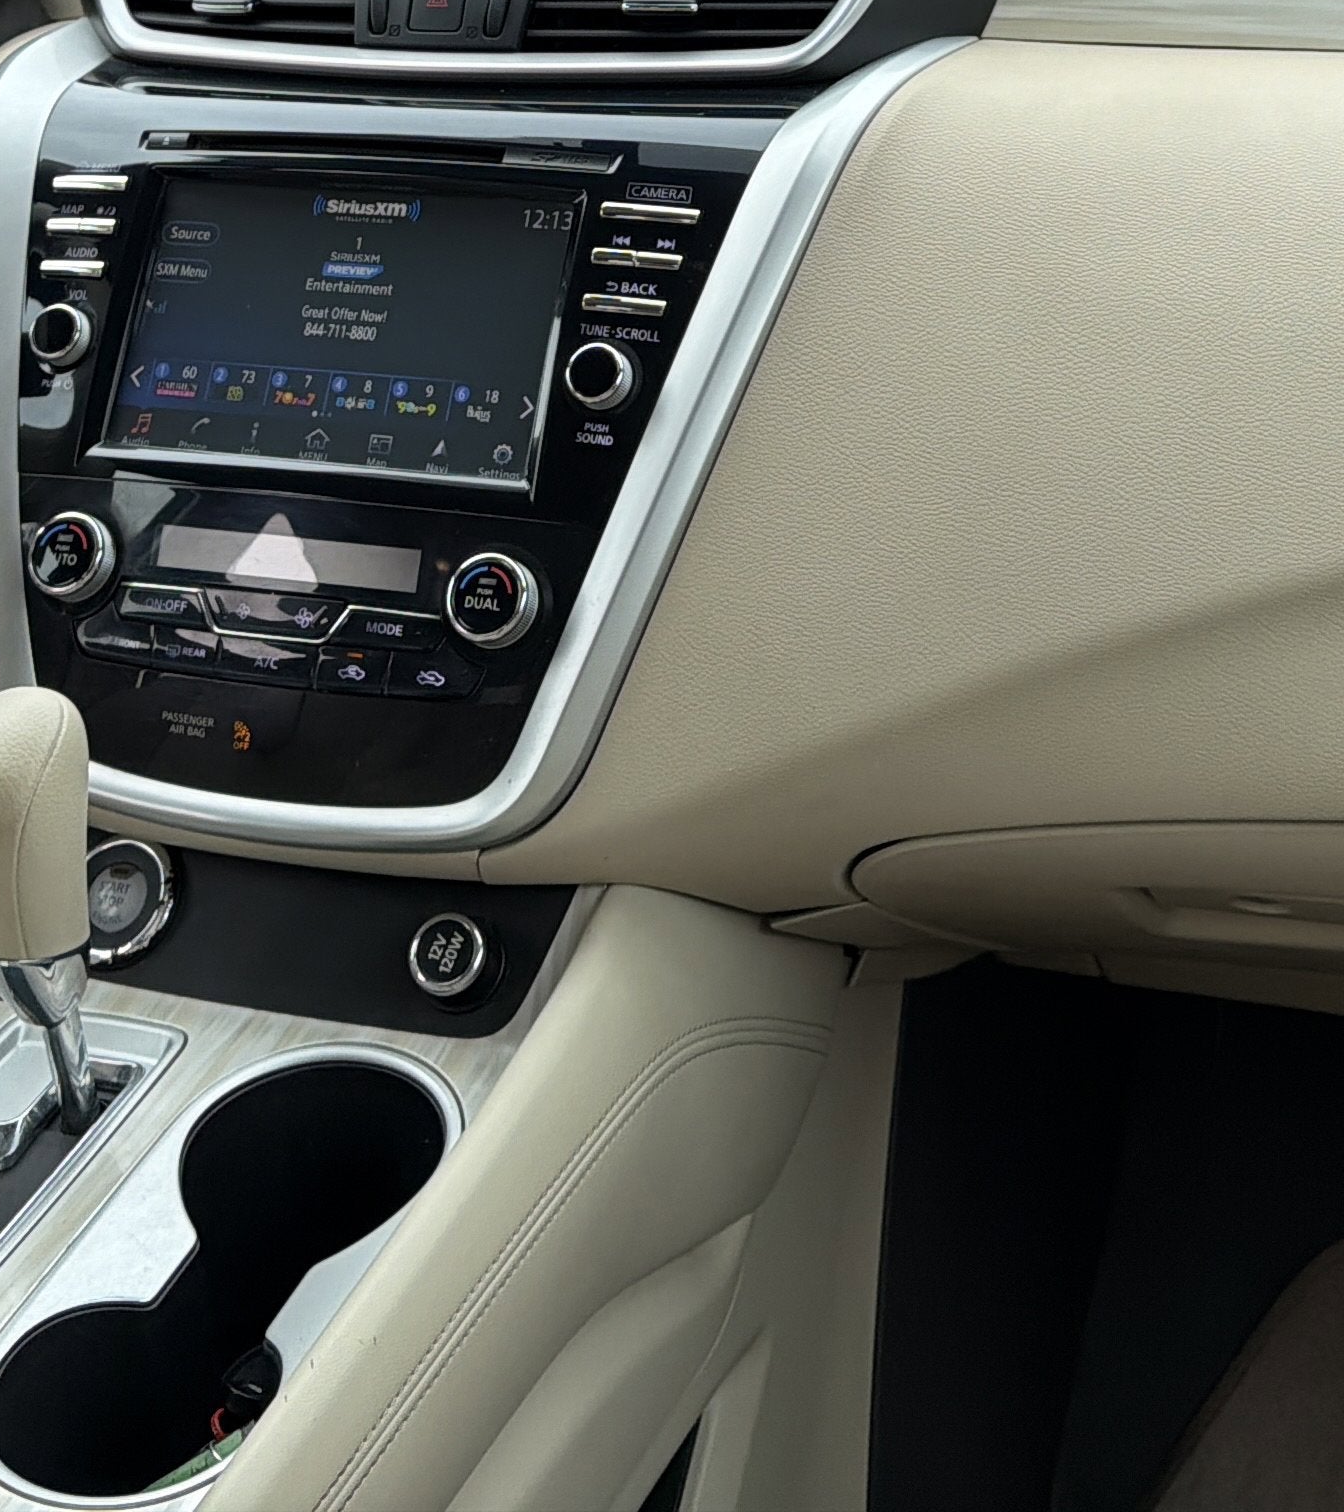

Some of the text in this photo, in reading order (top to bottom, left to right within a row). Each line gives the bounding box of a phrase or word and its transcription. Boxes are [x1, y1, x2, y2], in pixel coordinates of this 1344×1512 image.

[631, 185, 688, 201] CAMERA
[60, 204, 85, 215] MAP
[522, 209, 575, 230] 12:13
[169, 226, 212, 241] Source
[356, 236, 364, 250] 1
[64, 247, 99, 258] AUDIO
[329, 250, 382, 264] SIRIUSXM
[156, 262, 209, 278] SXM Menu
[305, 277, 394, 296] Entertainment
[620, 282, 659, 296] BACK
[69, 289, 89, 301] VOL
[301, 304, 389, 324] Great Offer Now!
[303, 321, 378, 342] 844-711-8800
[182, 365, 198, 380] 60
[241, 370, 256, 384] 73
[304, 374, 313, 388] 7
[363, 379, 373, 394] 8
[425, 384, 435, 399] 9
[485, 389, 500, 404] 18
[584, 422, 610, 433] PUSH
[121, 435, 151, 447] Audio
[575, 432, 614, 446] SOUND
[425, 462, 449, 475] Navi
[464, 595, 501, 612] DUAL
[366, 621, 404, 637] MODE
[181, 646, 207, 658] REAR
[253, 655, 280, 670] A/C
[161, 710, 215, 727] PASSENGER
[168, 723, 206, 738] AIR BAG
[232, 741, 249, 751] OFF
[427, 932, 447, 961] 12V
[438, 930, 465, 974] 120W
